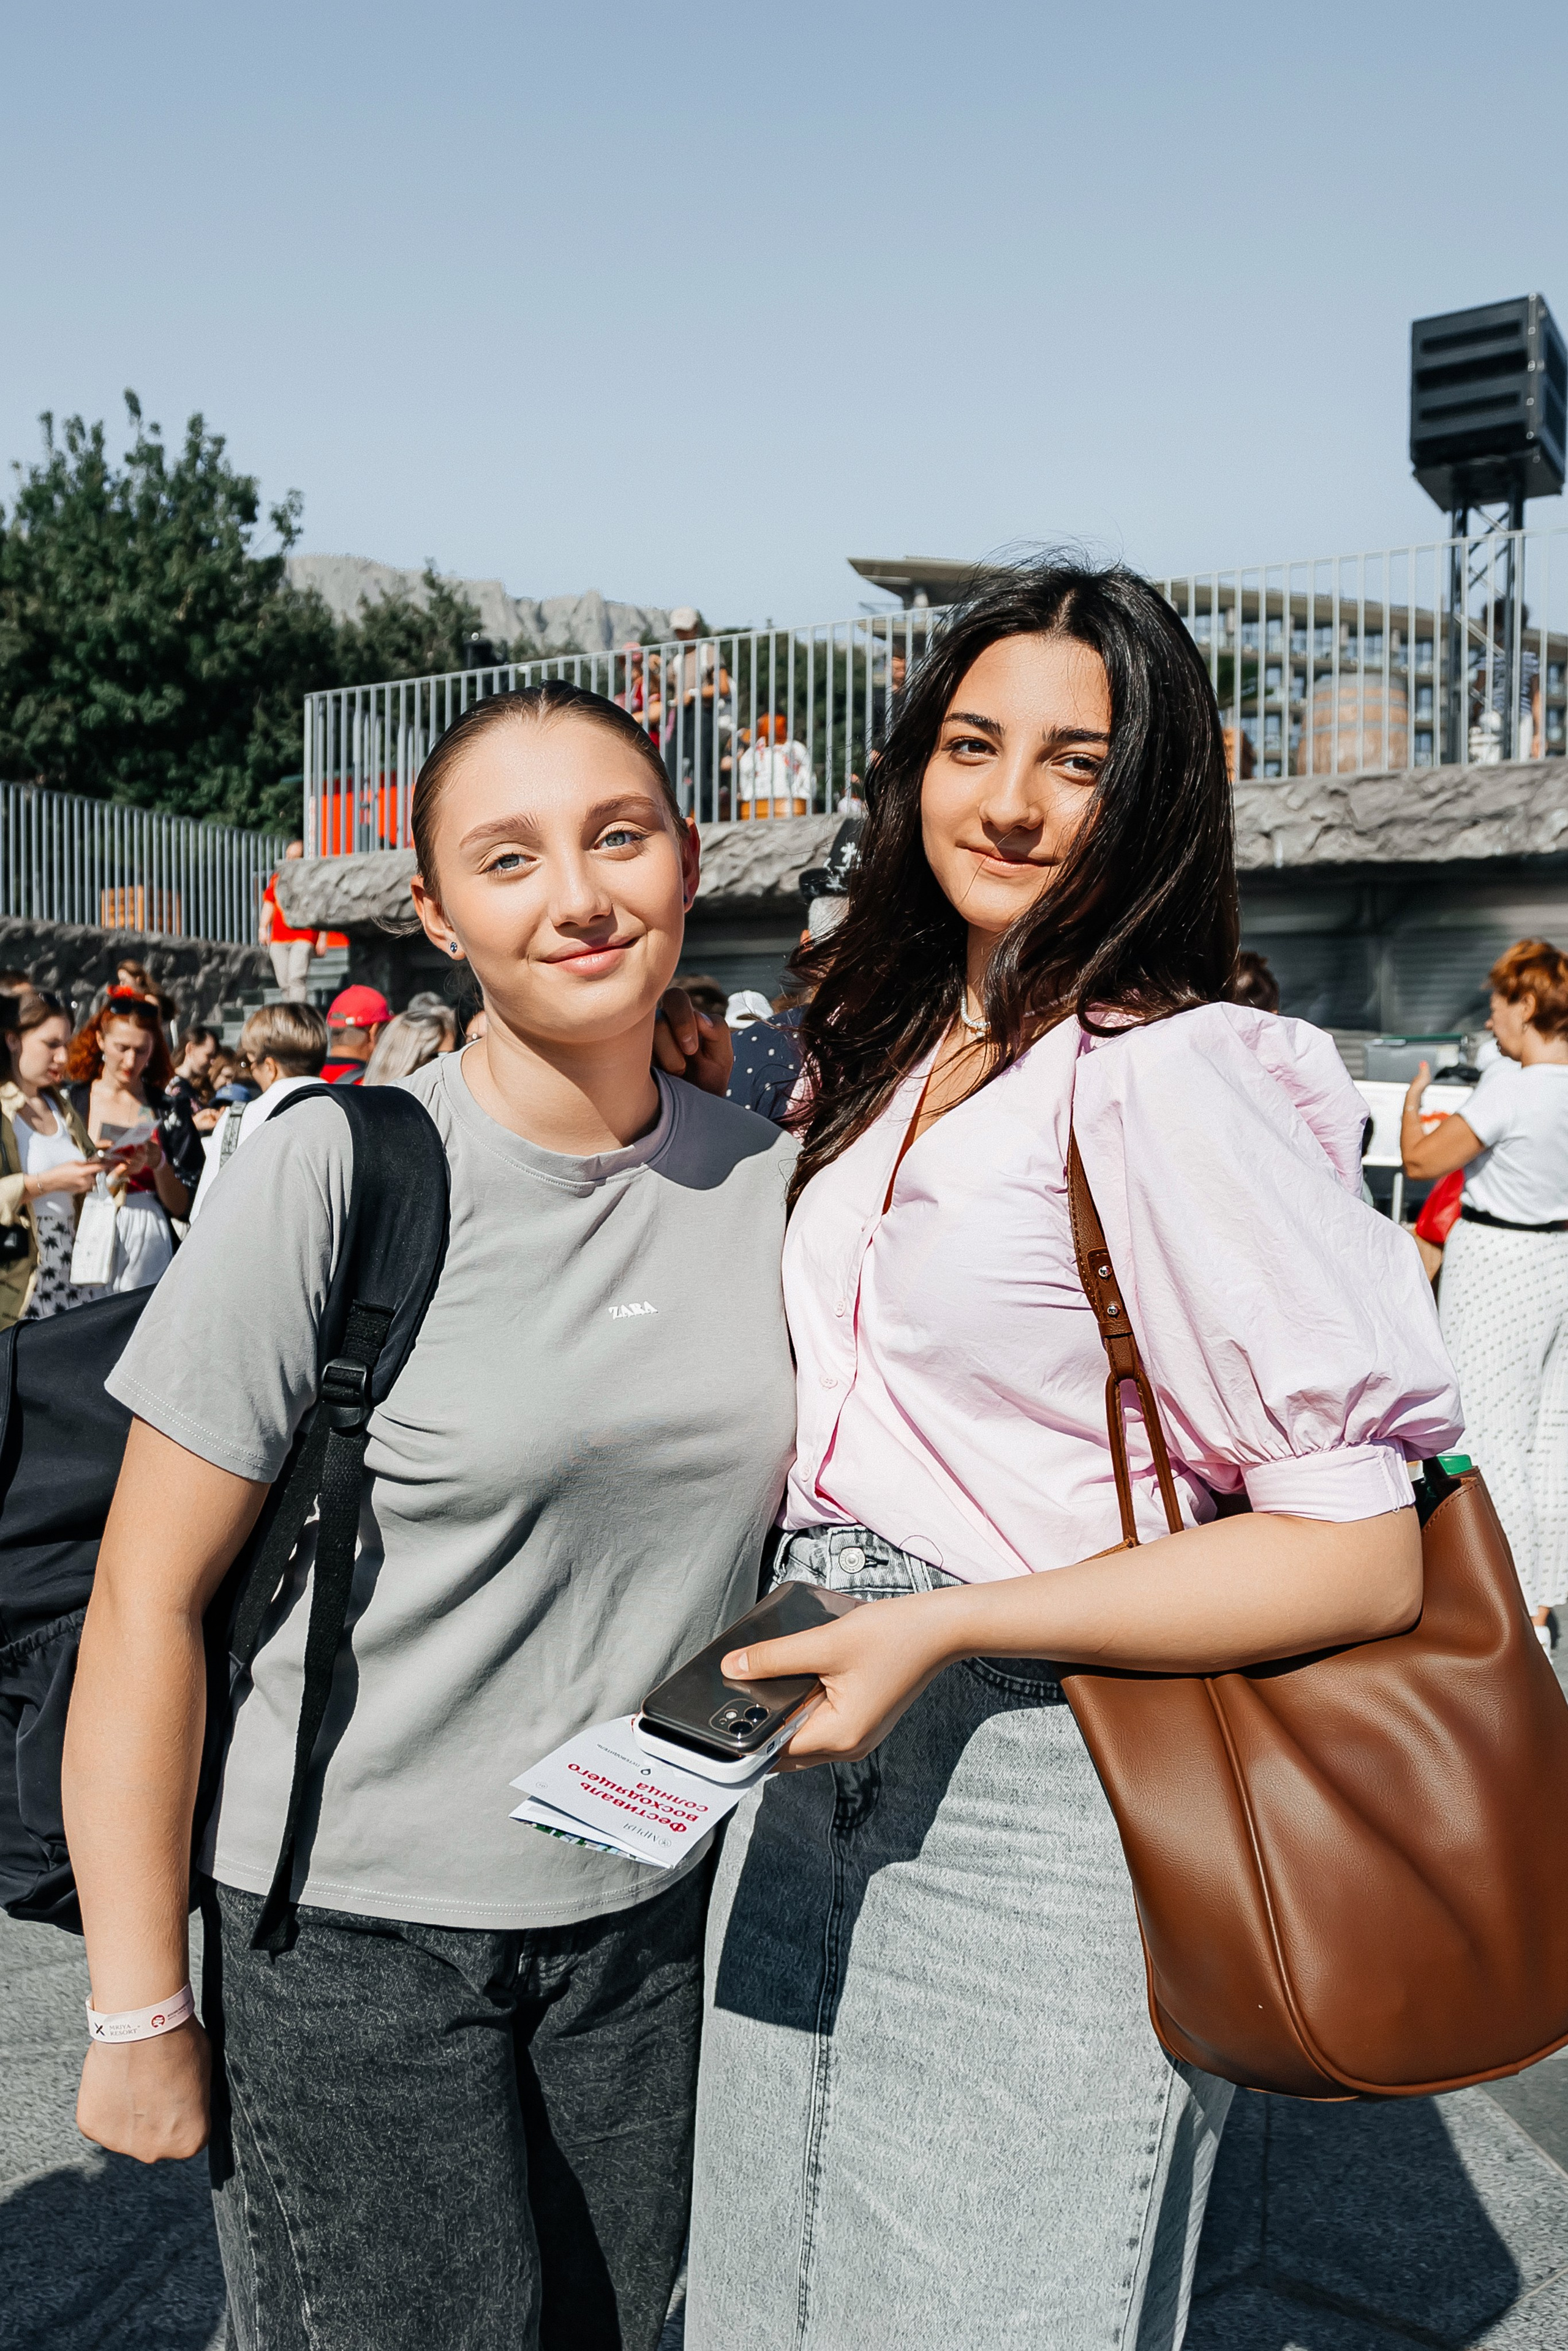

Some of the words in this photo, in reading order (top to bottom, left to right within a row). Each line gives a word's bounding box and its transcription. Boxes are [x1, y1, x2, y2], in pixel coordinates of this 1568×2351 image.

[608, 1301, 658, 1319] ZARA
[597, 1743, 640, 1767] ПУТЕВОДИТЕЛЬ
[567, 1763, 699, 1822] восходящего
[580, 1781, 687, 1833] Фестиваль
[636, 1782, 709, 1813] солнца
